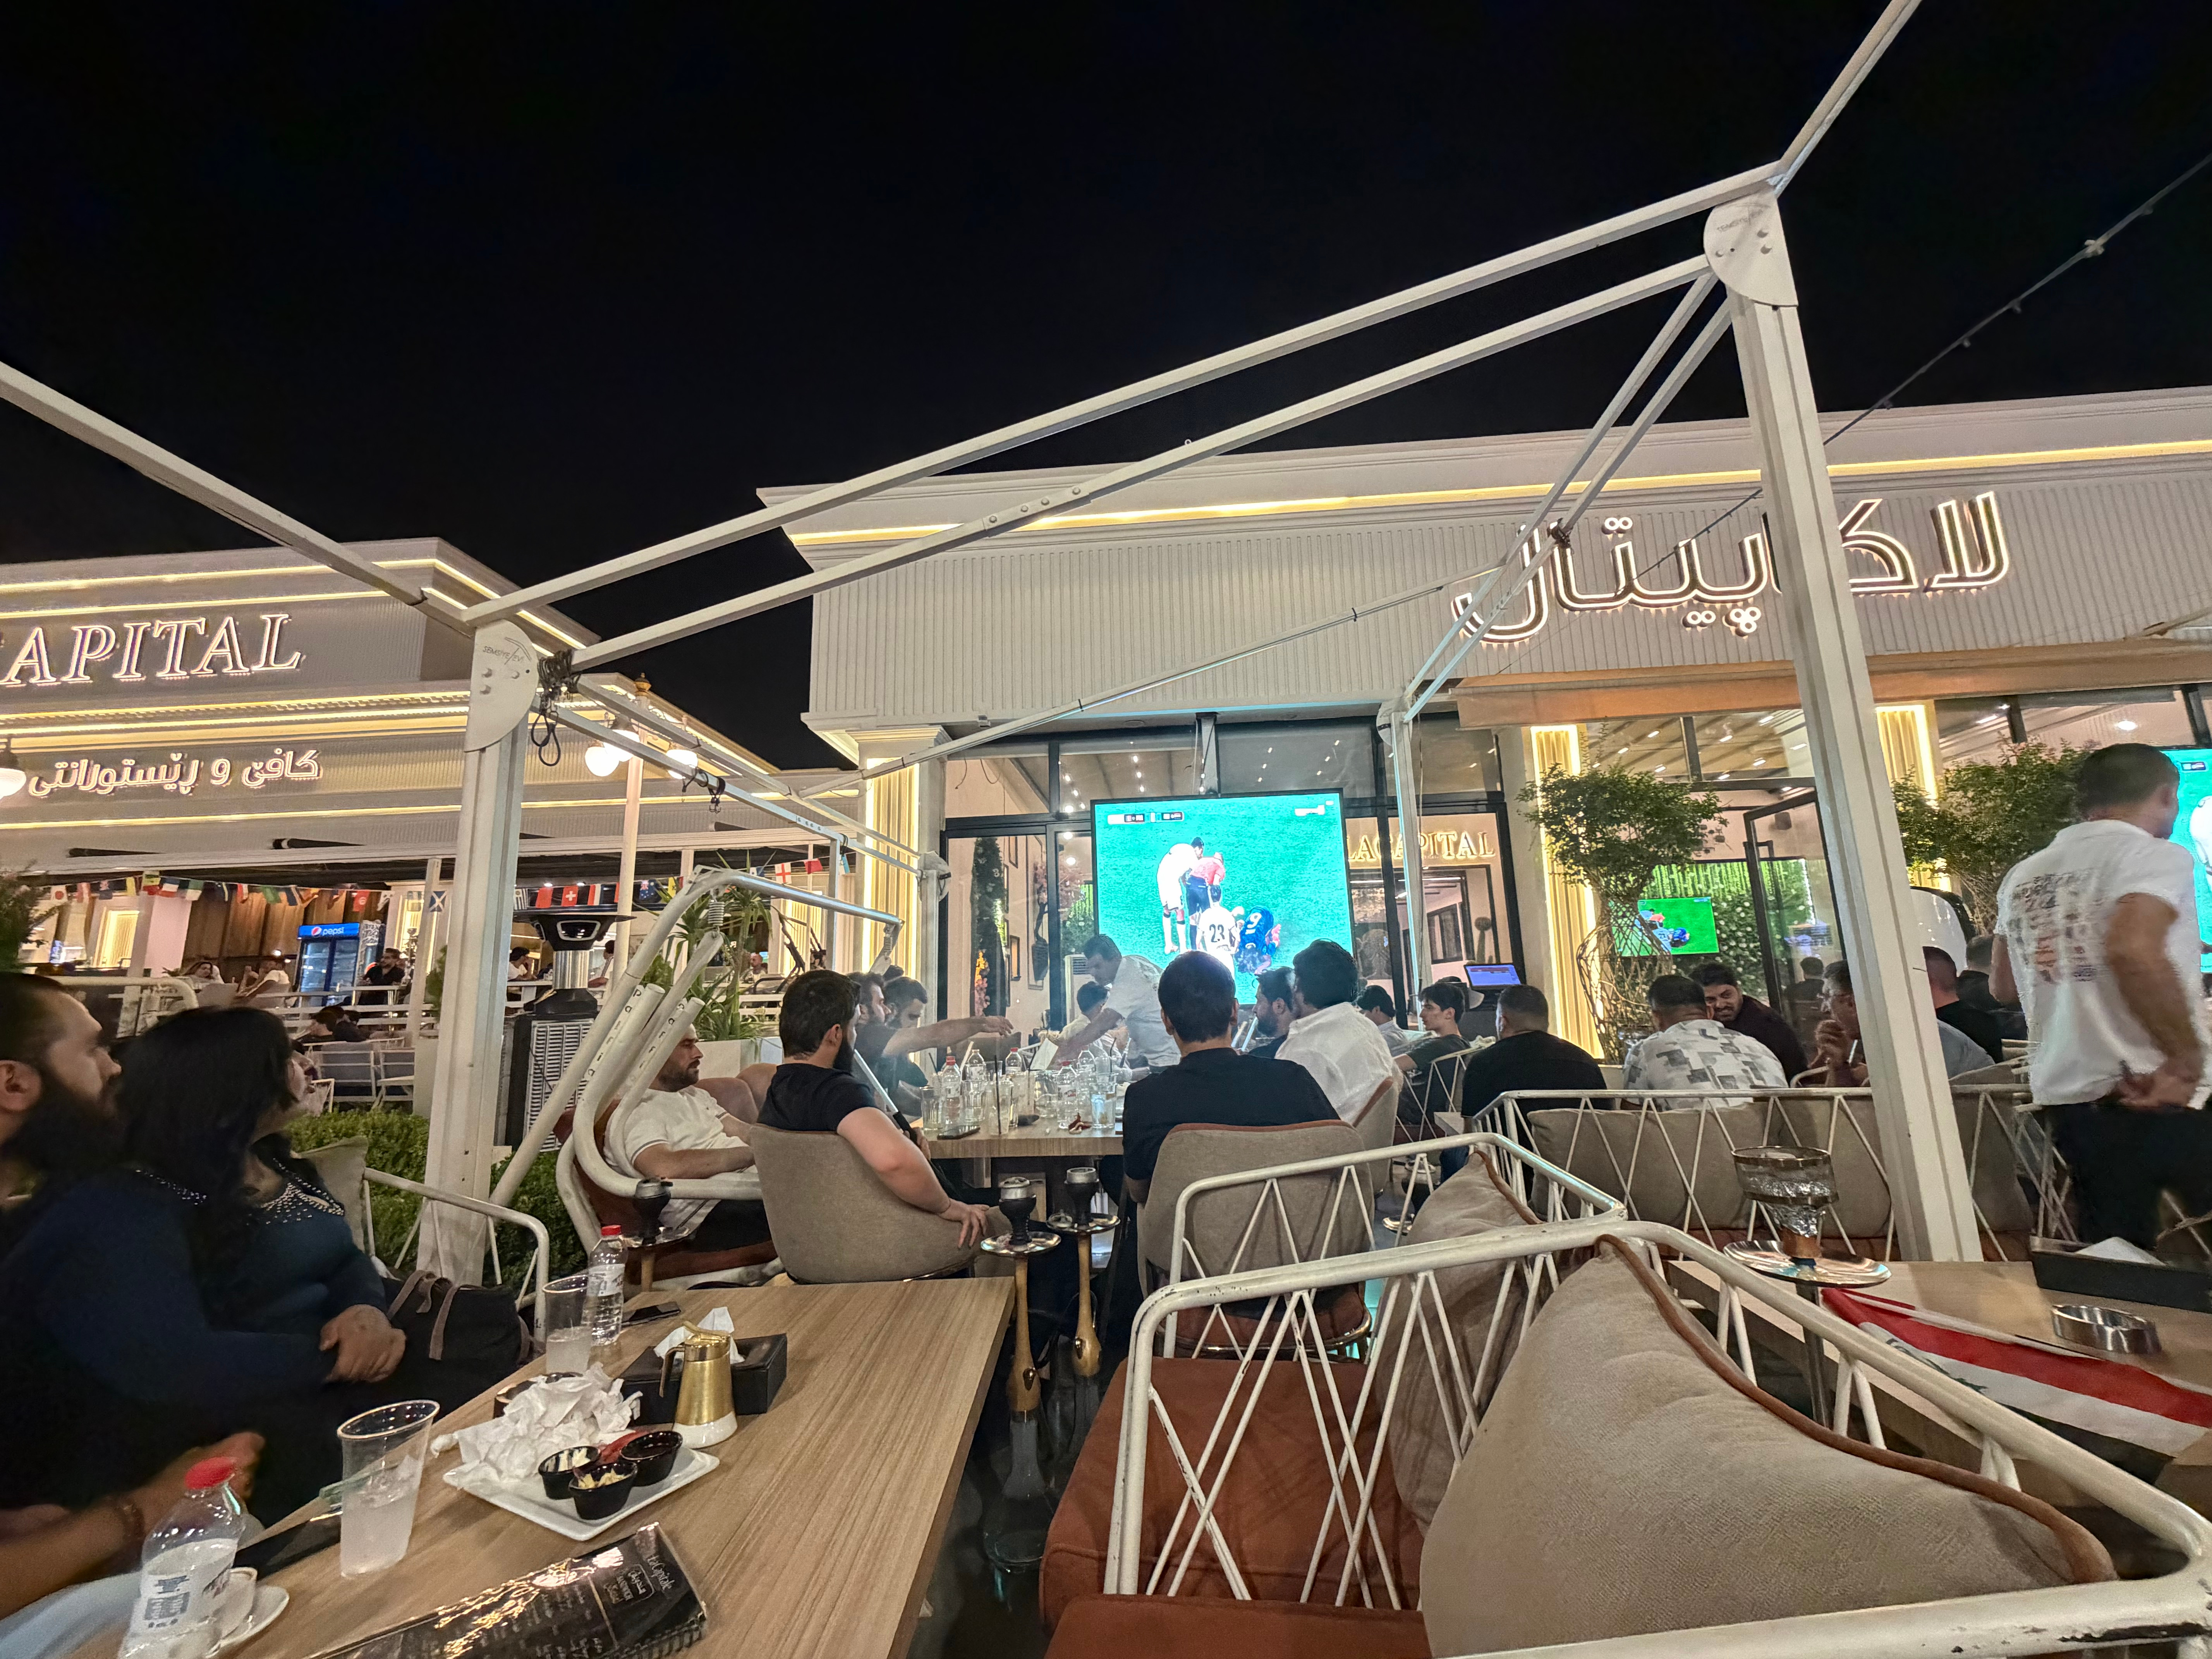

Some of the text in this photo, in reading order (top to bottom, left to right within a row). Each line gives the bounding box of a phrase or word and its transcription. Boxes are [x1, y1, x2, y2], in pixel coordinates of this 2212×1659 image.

[1247, 912, 1262, 929] 9
[322, 926, 345, 936] pepsi
[1209, 924, 1225, 943] 23
